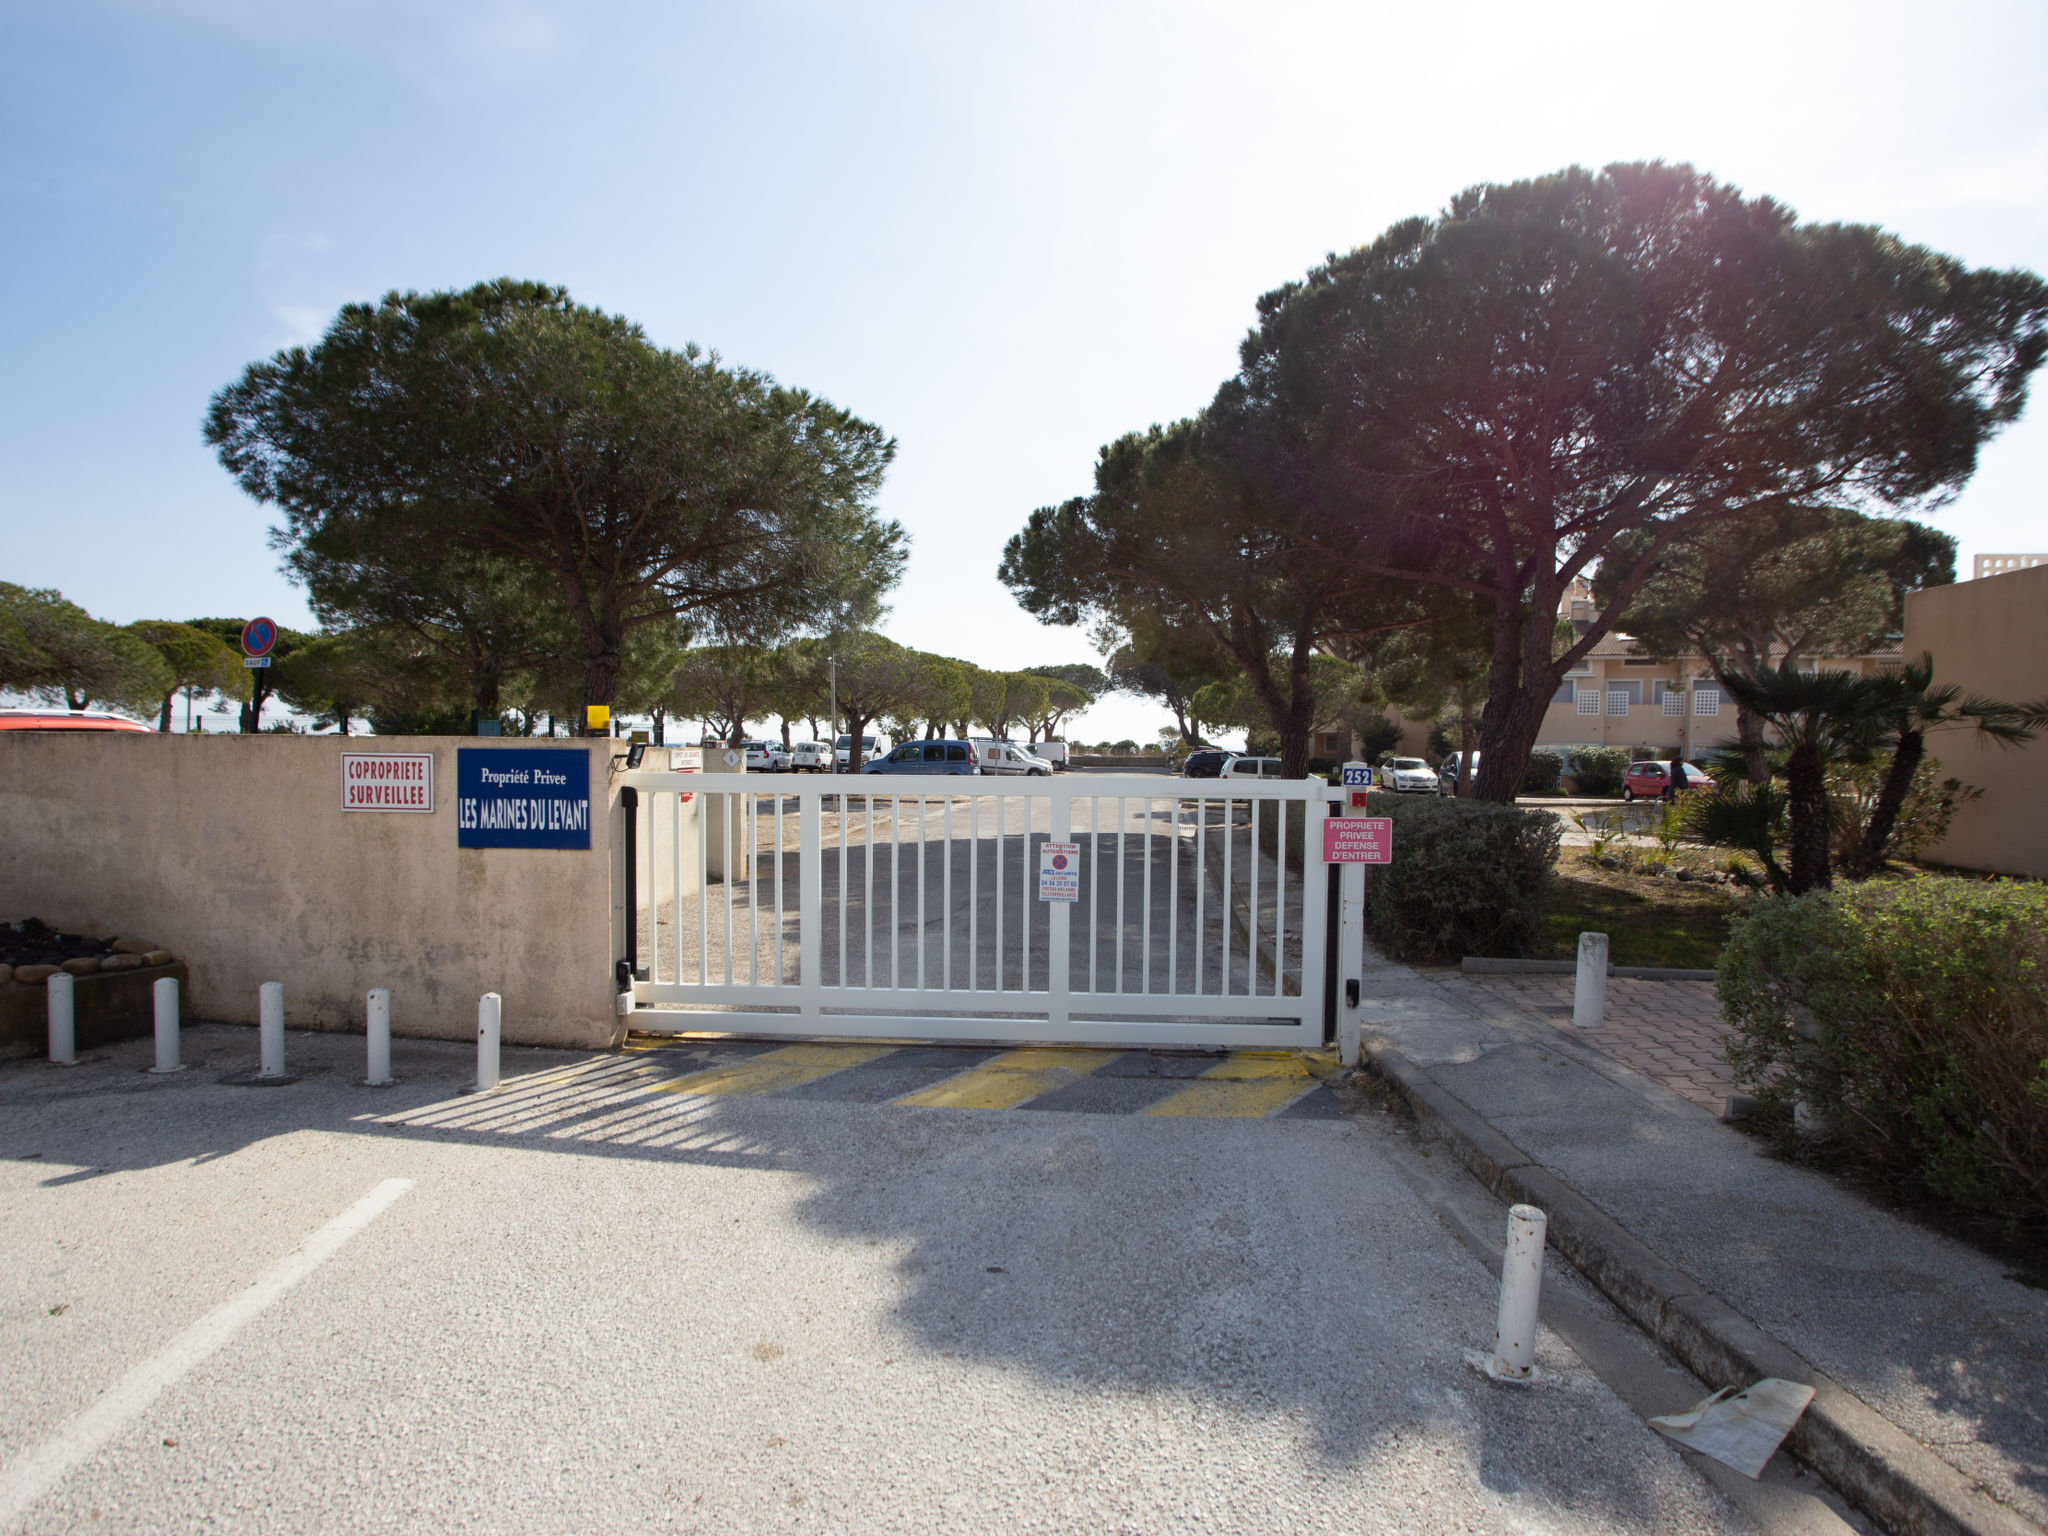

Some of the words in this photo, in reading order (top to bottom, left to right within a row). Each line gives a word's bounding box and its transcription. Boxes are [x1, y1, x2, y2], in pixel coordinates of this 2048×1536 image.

[349, 760, 424, 780] COPROPRIETE
[1346, 770, 1370, 784] 252
[481, 767, 529, 788] Propriété
[533, 769, 567, 785] Privee
[349, 785, 424, 805] SURVEILLEE
[459, 798, 477, 829] LES
[480, 798, 527, 830] MARINES
[530, 798, 545, 830] DU
[548, 799, 588, 831] LEVANT
[1329, 821, 1384, 830] PROPRIETE
[1339, 831, 1374, 840] PRIVEE
[1334, 841, 1379, 850] DEFENSE
[1332, 851, 1381, 860] D'ENTRER
